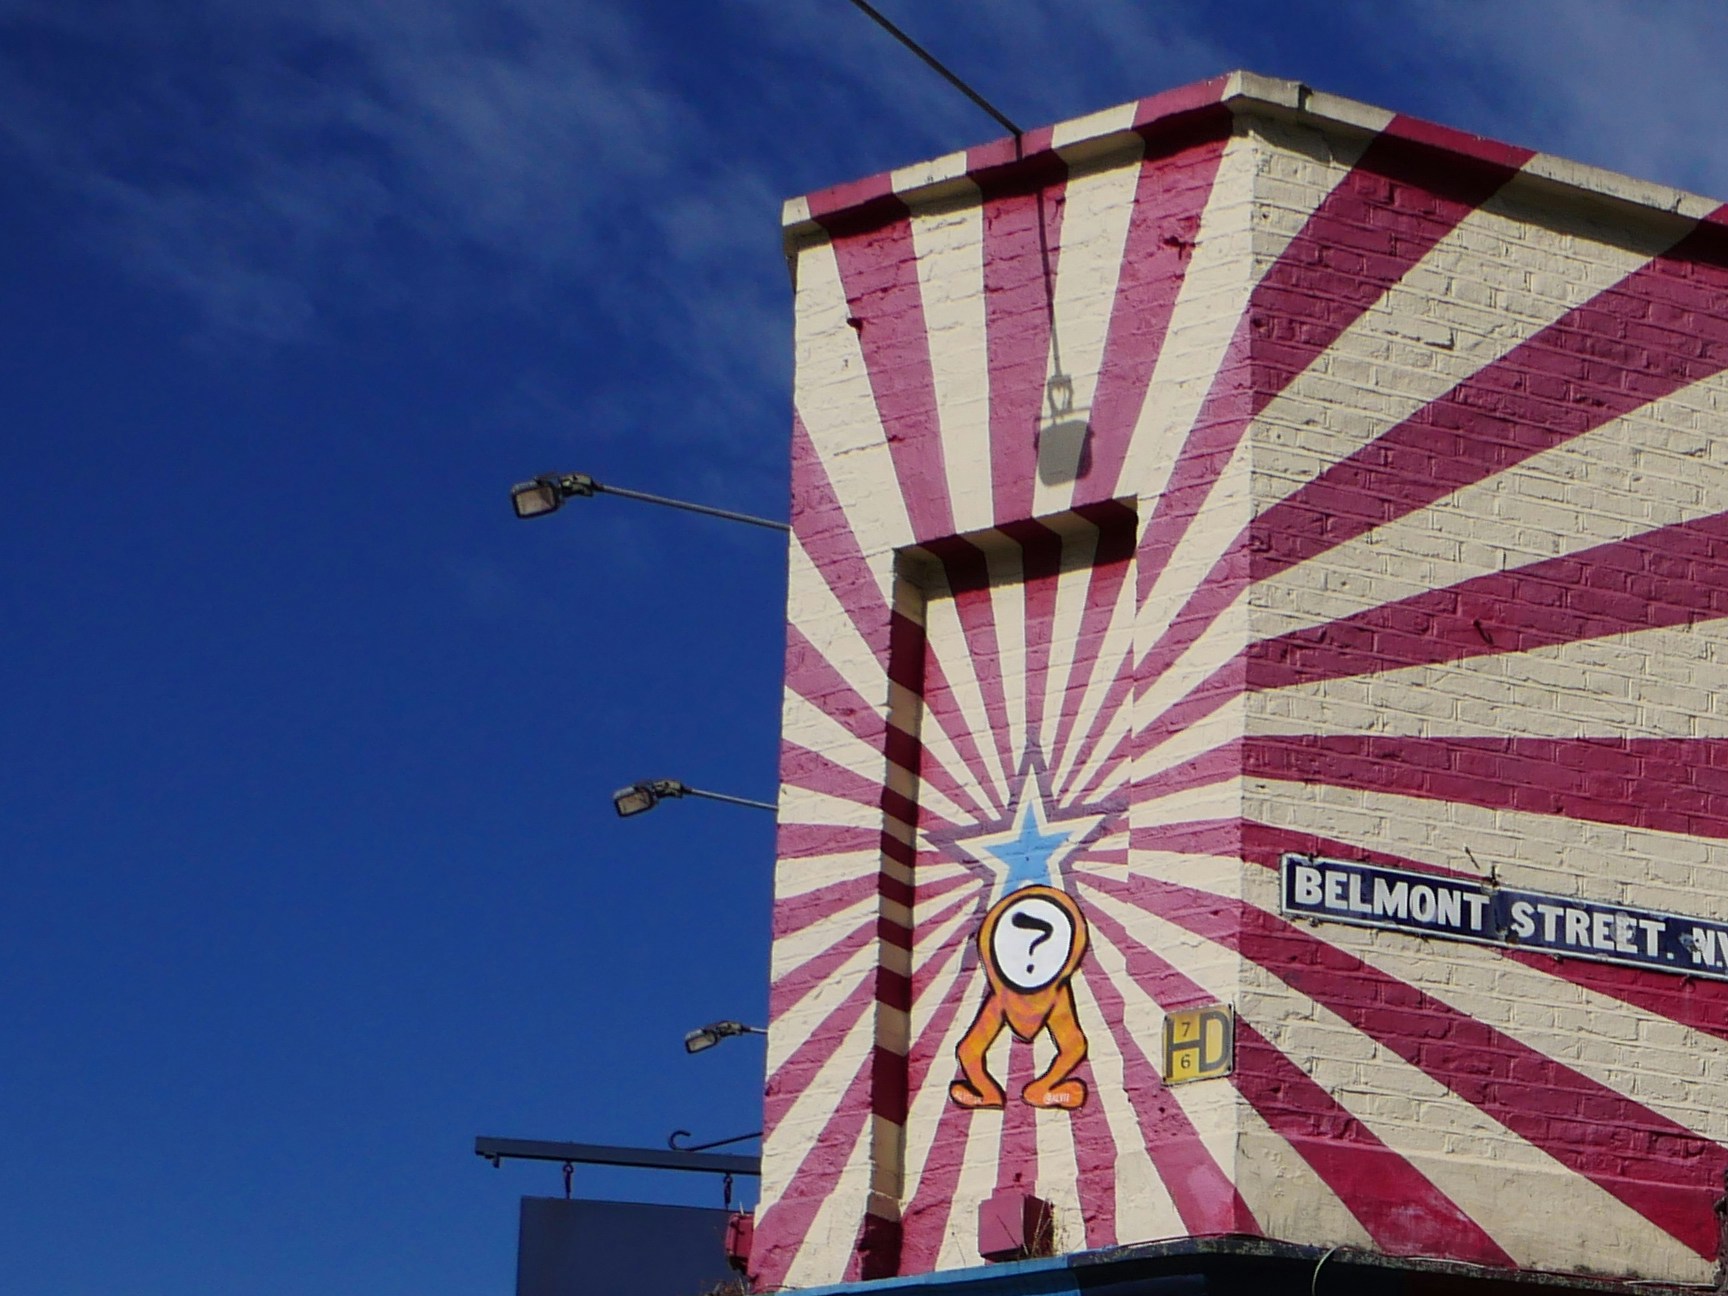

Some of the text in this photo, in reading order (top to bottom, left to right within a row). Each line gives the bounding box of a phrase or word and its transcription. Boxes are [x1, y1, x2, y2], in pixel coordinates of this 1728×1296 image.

[1294, 866, 1490, 930] BELMONT
[1182, 1021, 1191, 1038] 7
[1181, 1053, 1191, 1069] 6
